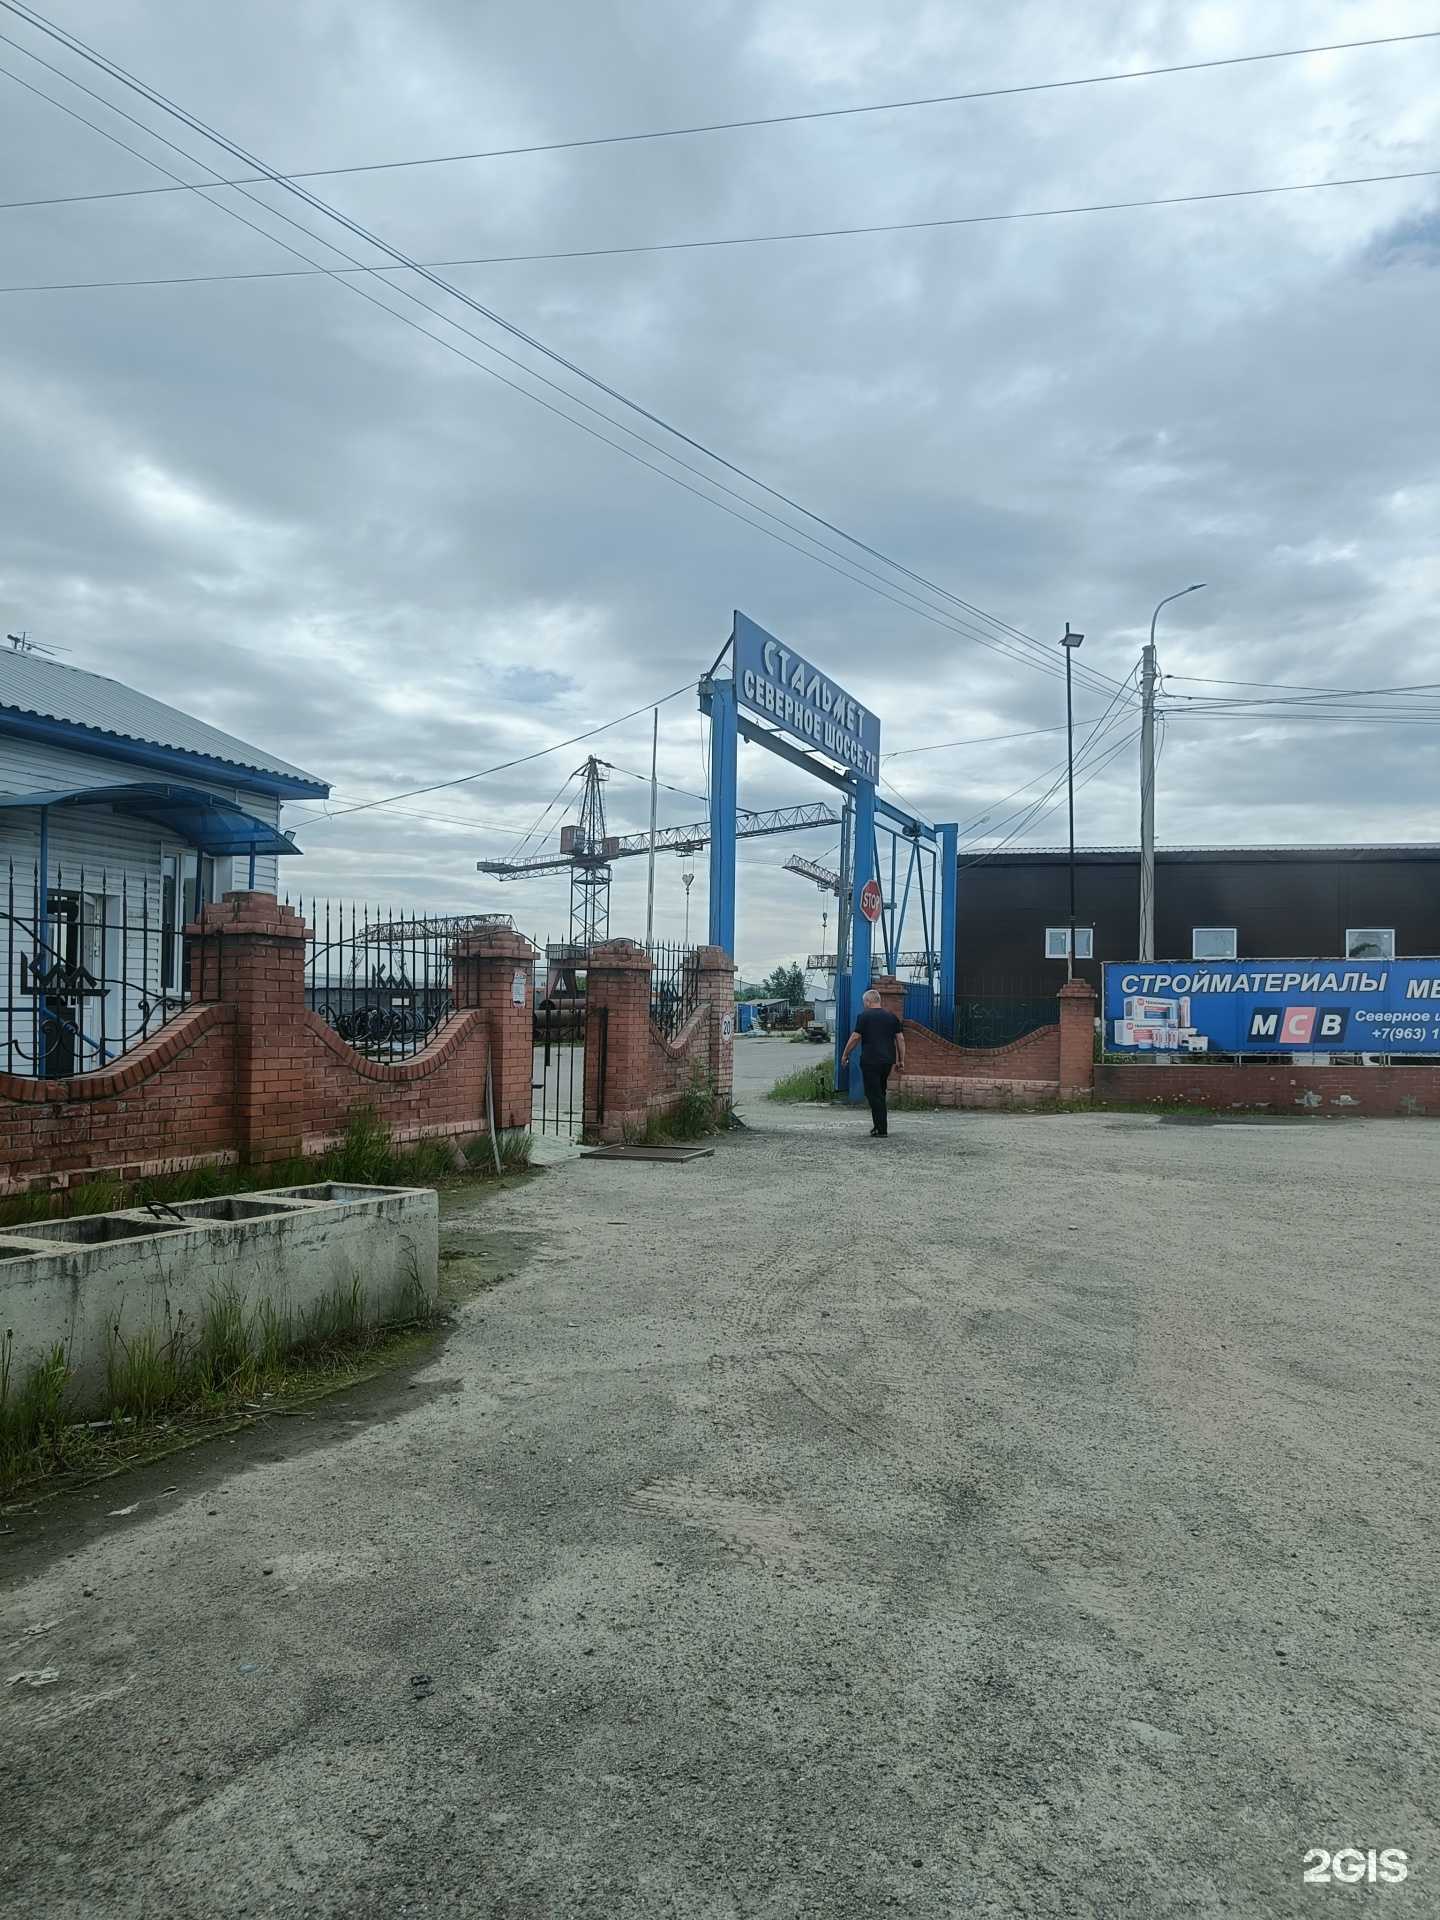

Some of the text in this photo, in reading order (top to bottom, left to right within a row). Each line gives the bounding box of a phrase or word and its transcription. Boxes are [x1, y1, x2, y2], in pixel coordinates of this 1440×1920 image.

[763, 639, 866, 738] СТАЛЬМЕТ
[743, 669, 821, 741] СЕВЕРНОЕ
[863, 892, 880, 911] STOP
[1120, 969, 1388, 994] СТРОЙМАТЕРИАЛЫ
[1354, 1010, 1431, 1025] Северное
[1371, 1027, 1427, 1042] +7(963)
